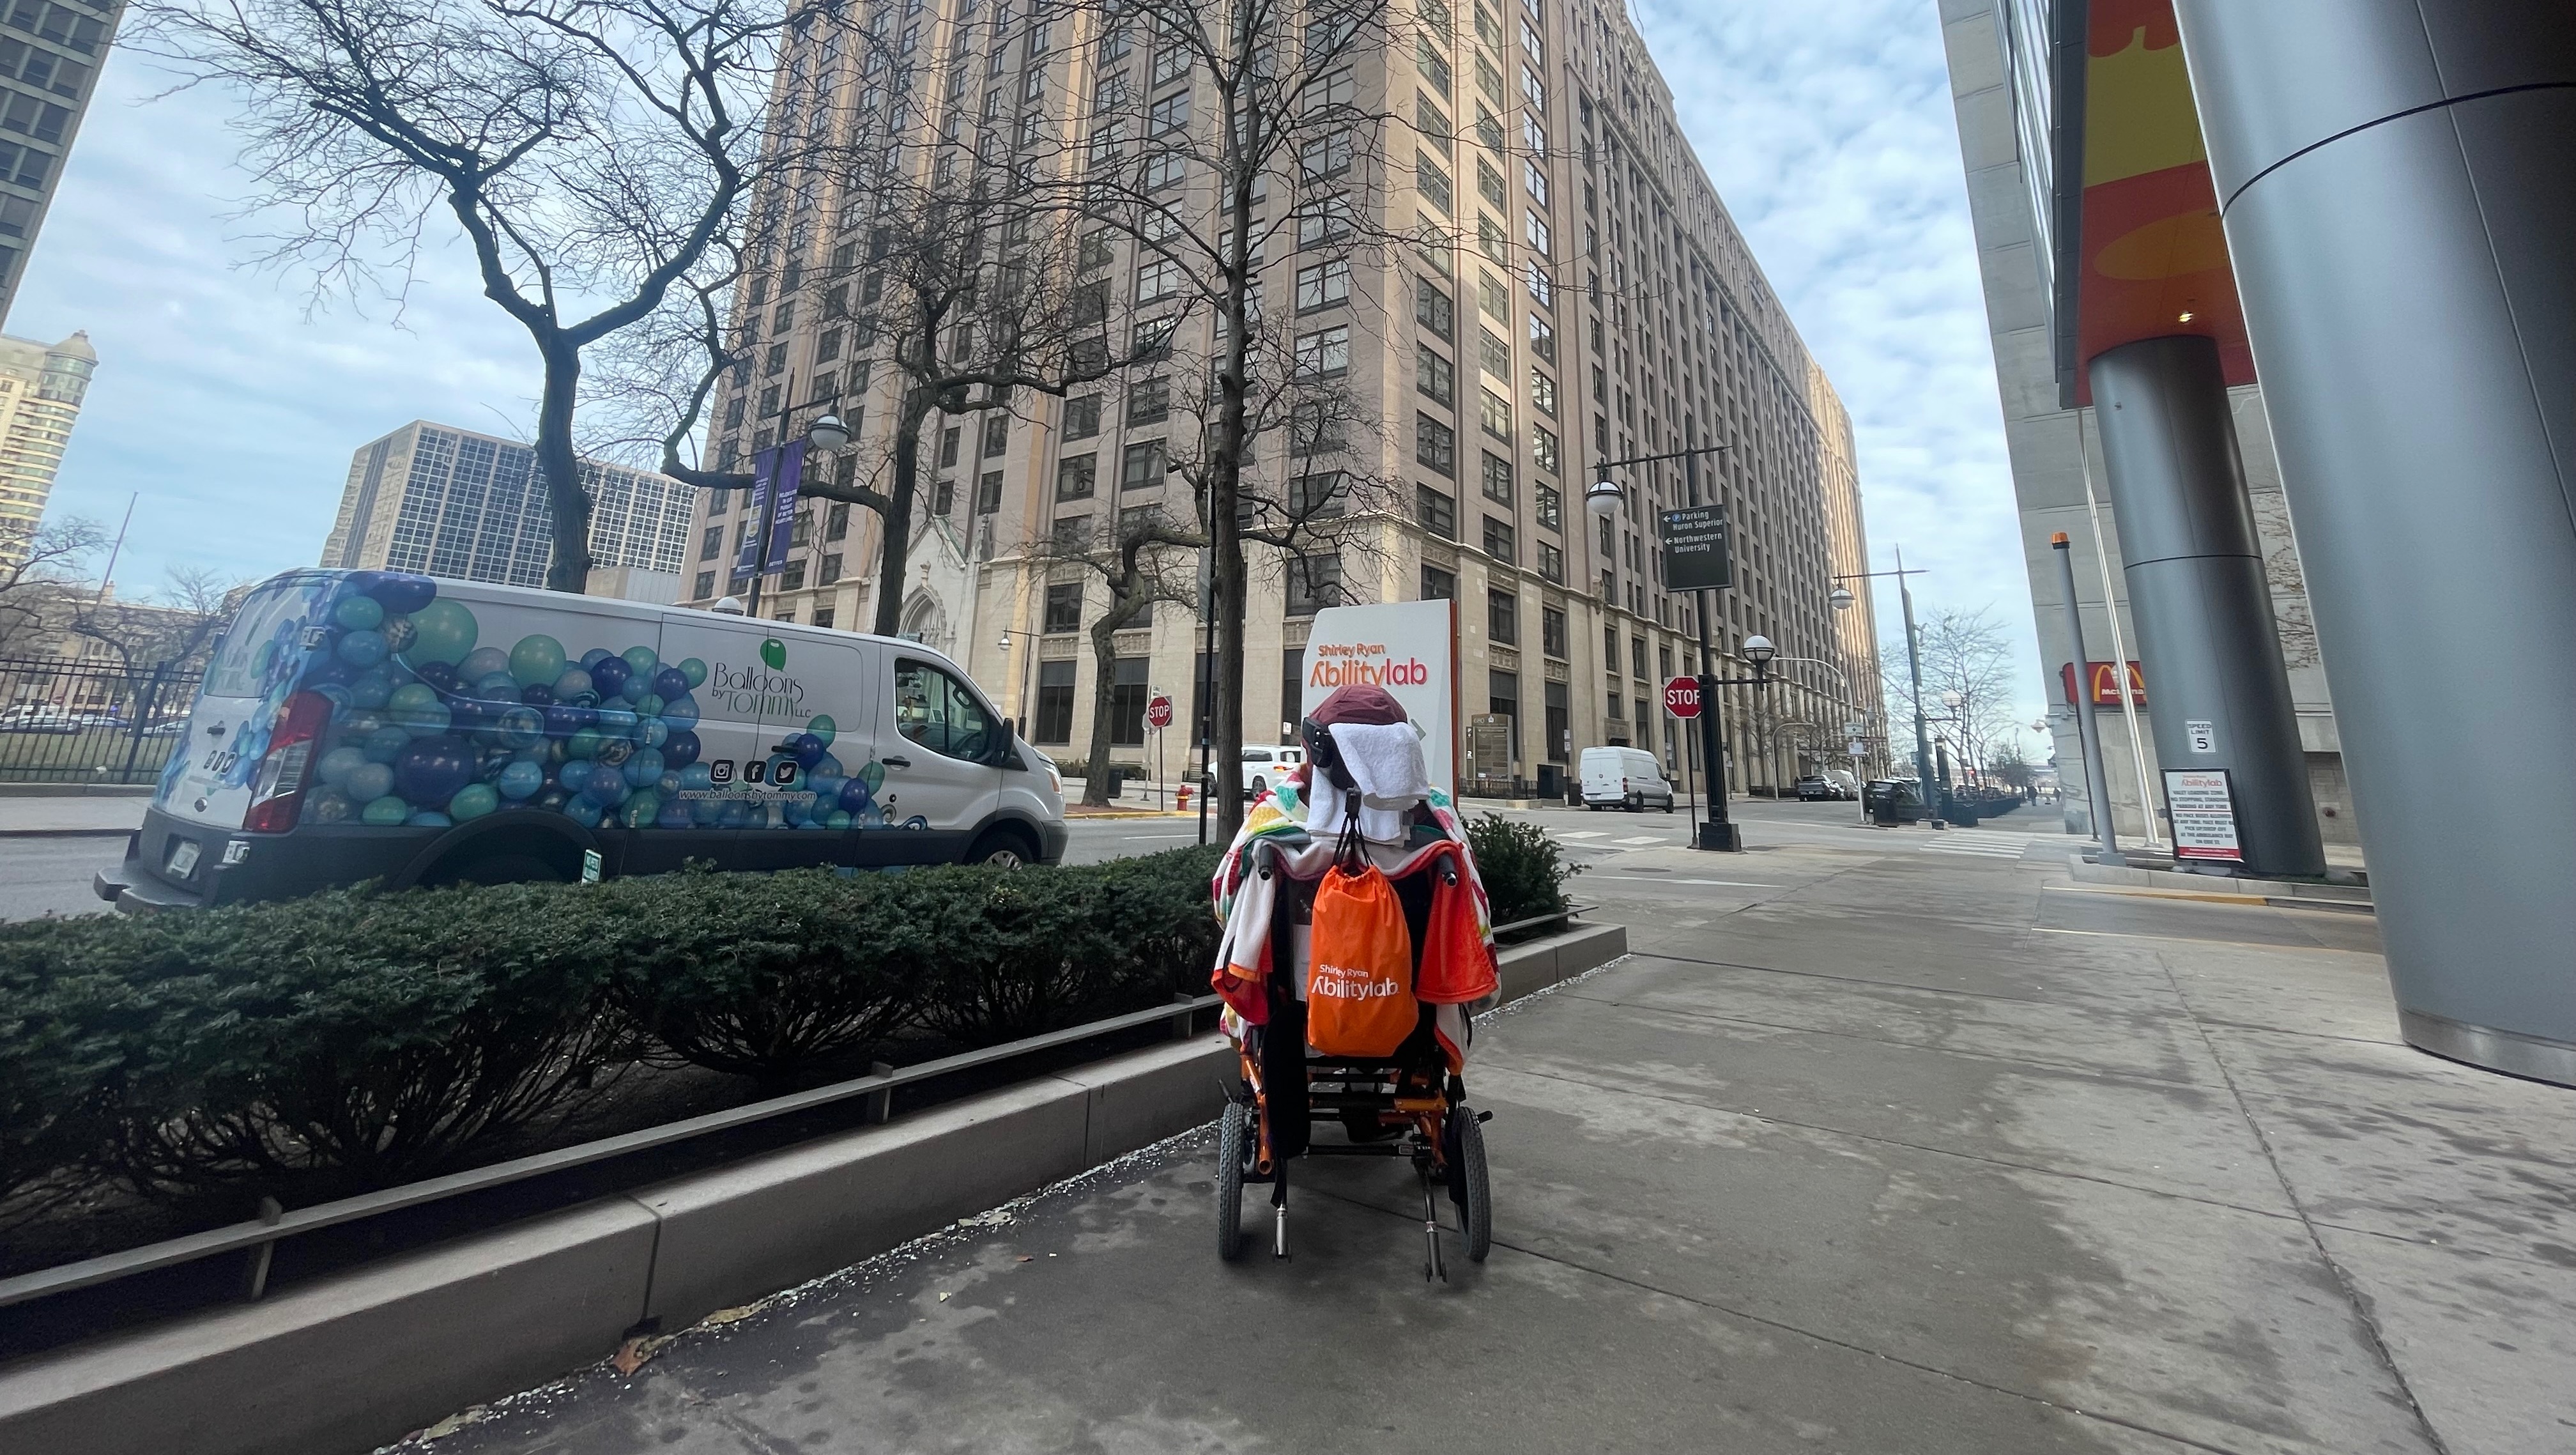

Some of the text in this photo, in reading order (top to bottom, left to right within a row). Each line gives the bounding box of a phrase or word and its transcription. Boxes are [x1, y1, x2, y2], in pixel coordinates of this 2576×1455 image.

[1682, 511, 1709, 520] Parking
[1695, 518, 1722, 529] Superior
[1674, 533, 1722, 544] Northwestern
[1675, 543, 1710, 553] University
[1318, 643, 1386, 658] Shirley Ryan
[1310, 658, 1428, 687] Abilitylab
[713, 662, 804, 704] Balloons
[712, 687, 725, 699] by
[795, 709, 811, 718] LLC
[1149, 705, 1170, 719] STOP
[2196, 737, 2208, 750] 5
[679, 789, 817, 802] www.balloonsbytommy.com
[1319, 964, 1368, 978] Shirley Ryan
[1311, 975, 1400, 1001] Abilitylab
